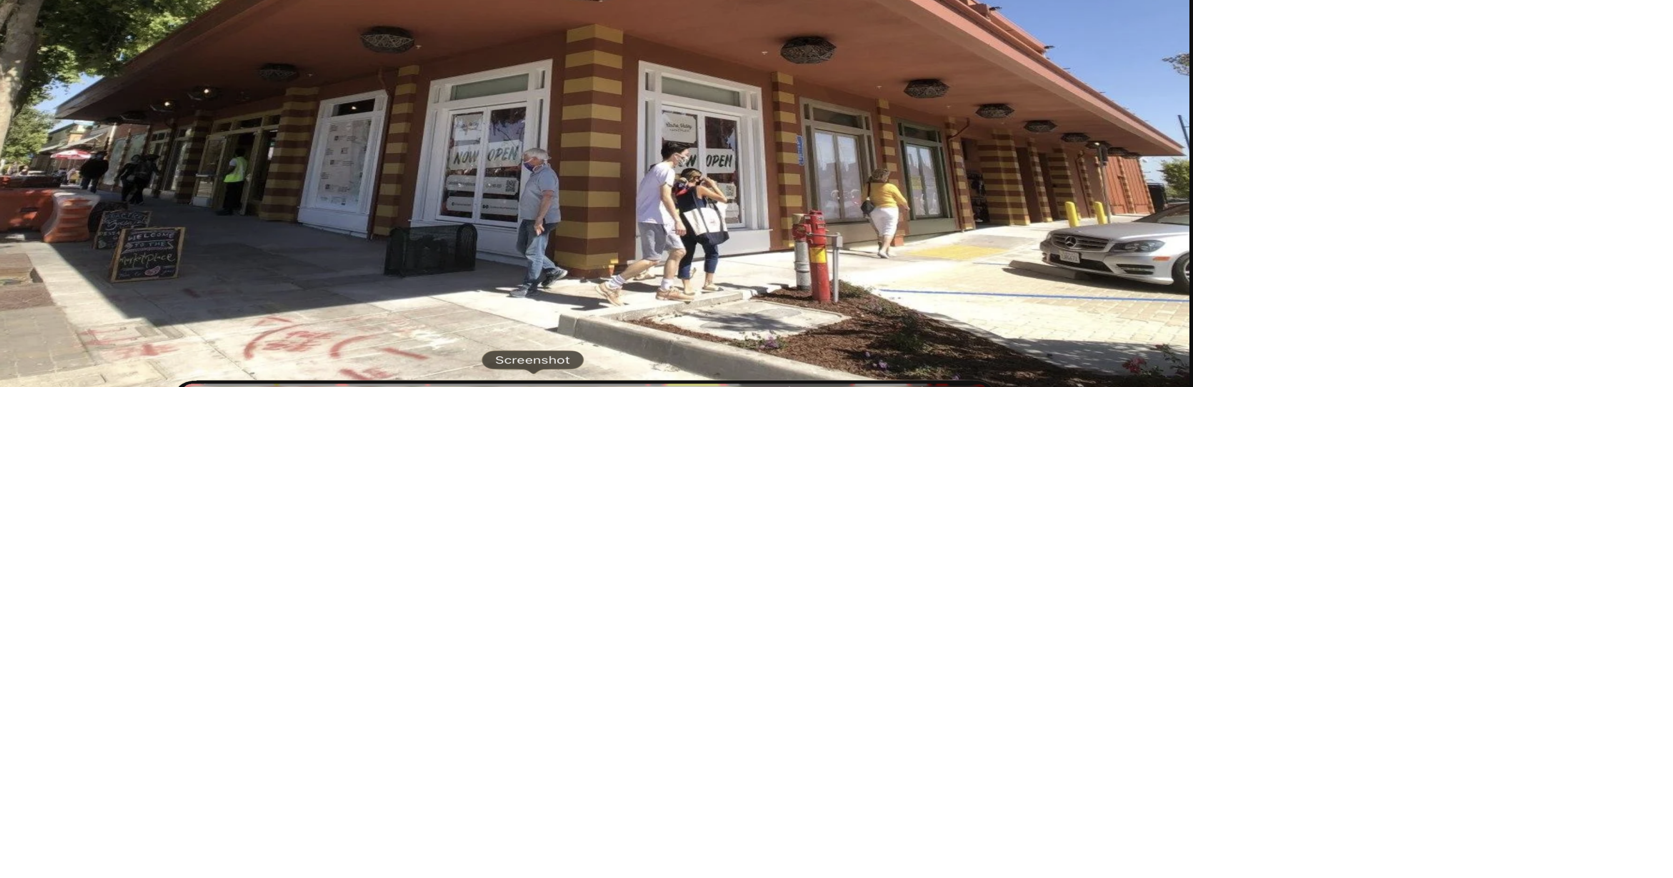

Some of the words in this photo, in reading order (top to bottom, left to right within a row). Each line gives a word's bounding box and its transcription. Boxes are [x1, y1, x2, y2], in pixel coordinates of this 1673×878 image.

[453, 150, 480, 165] NOW
[487, 145, 520, 161] OPEN
[705, 154, 733, 168] OPEN
[128, 232, 175, 241] WELCOME
